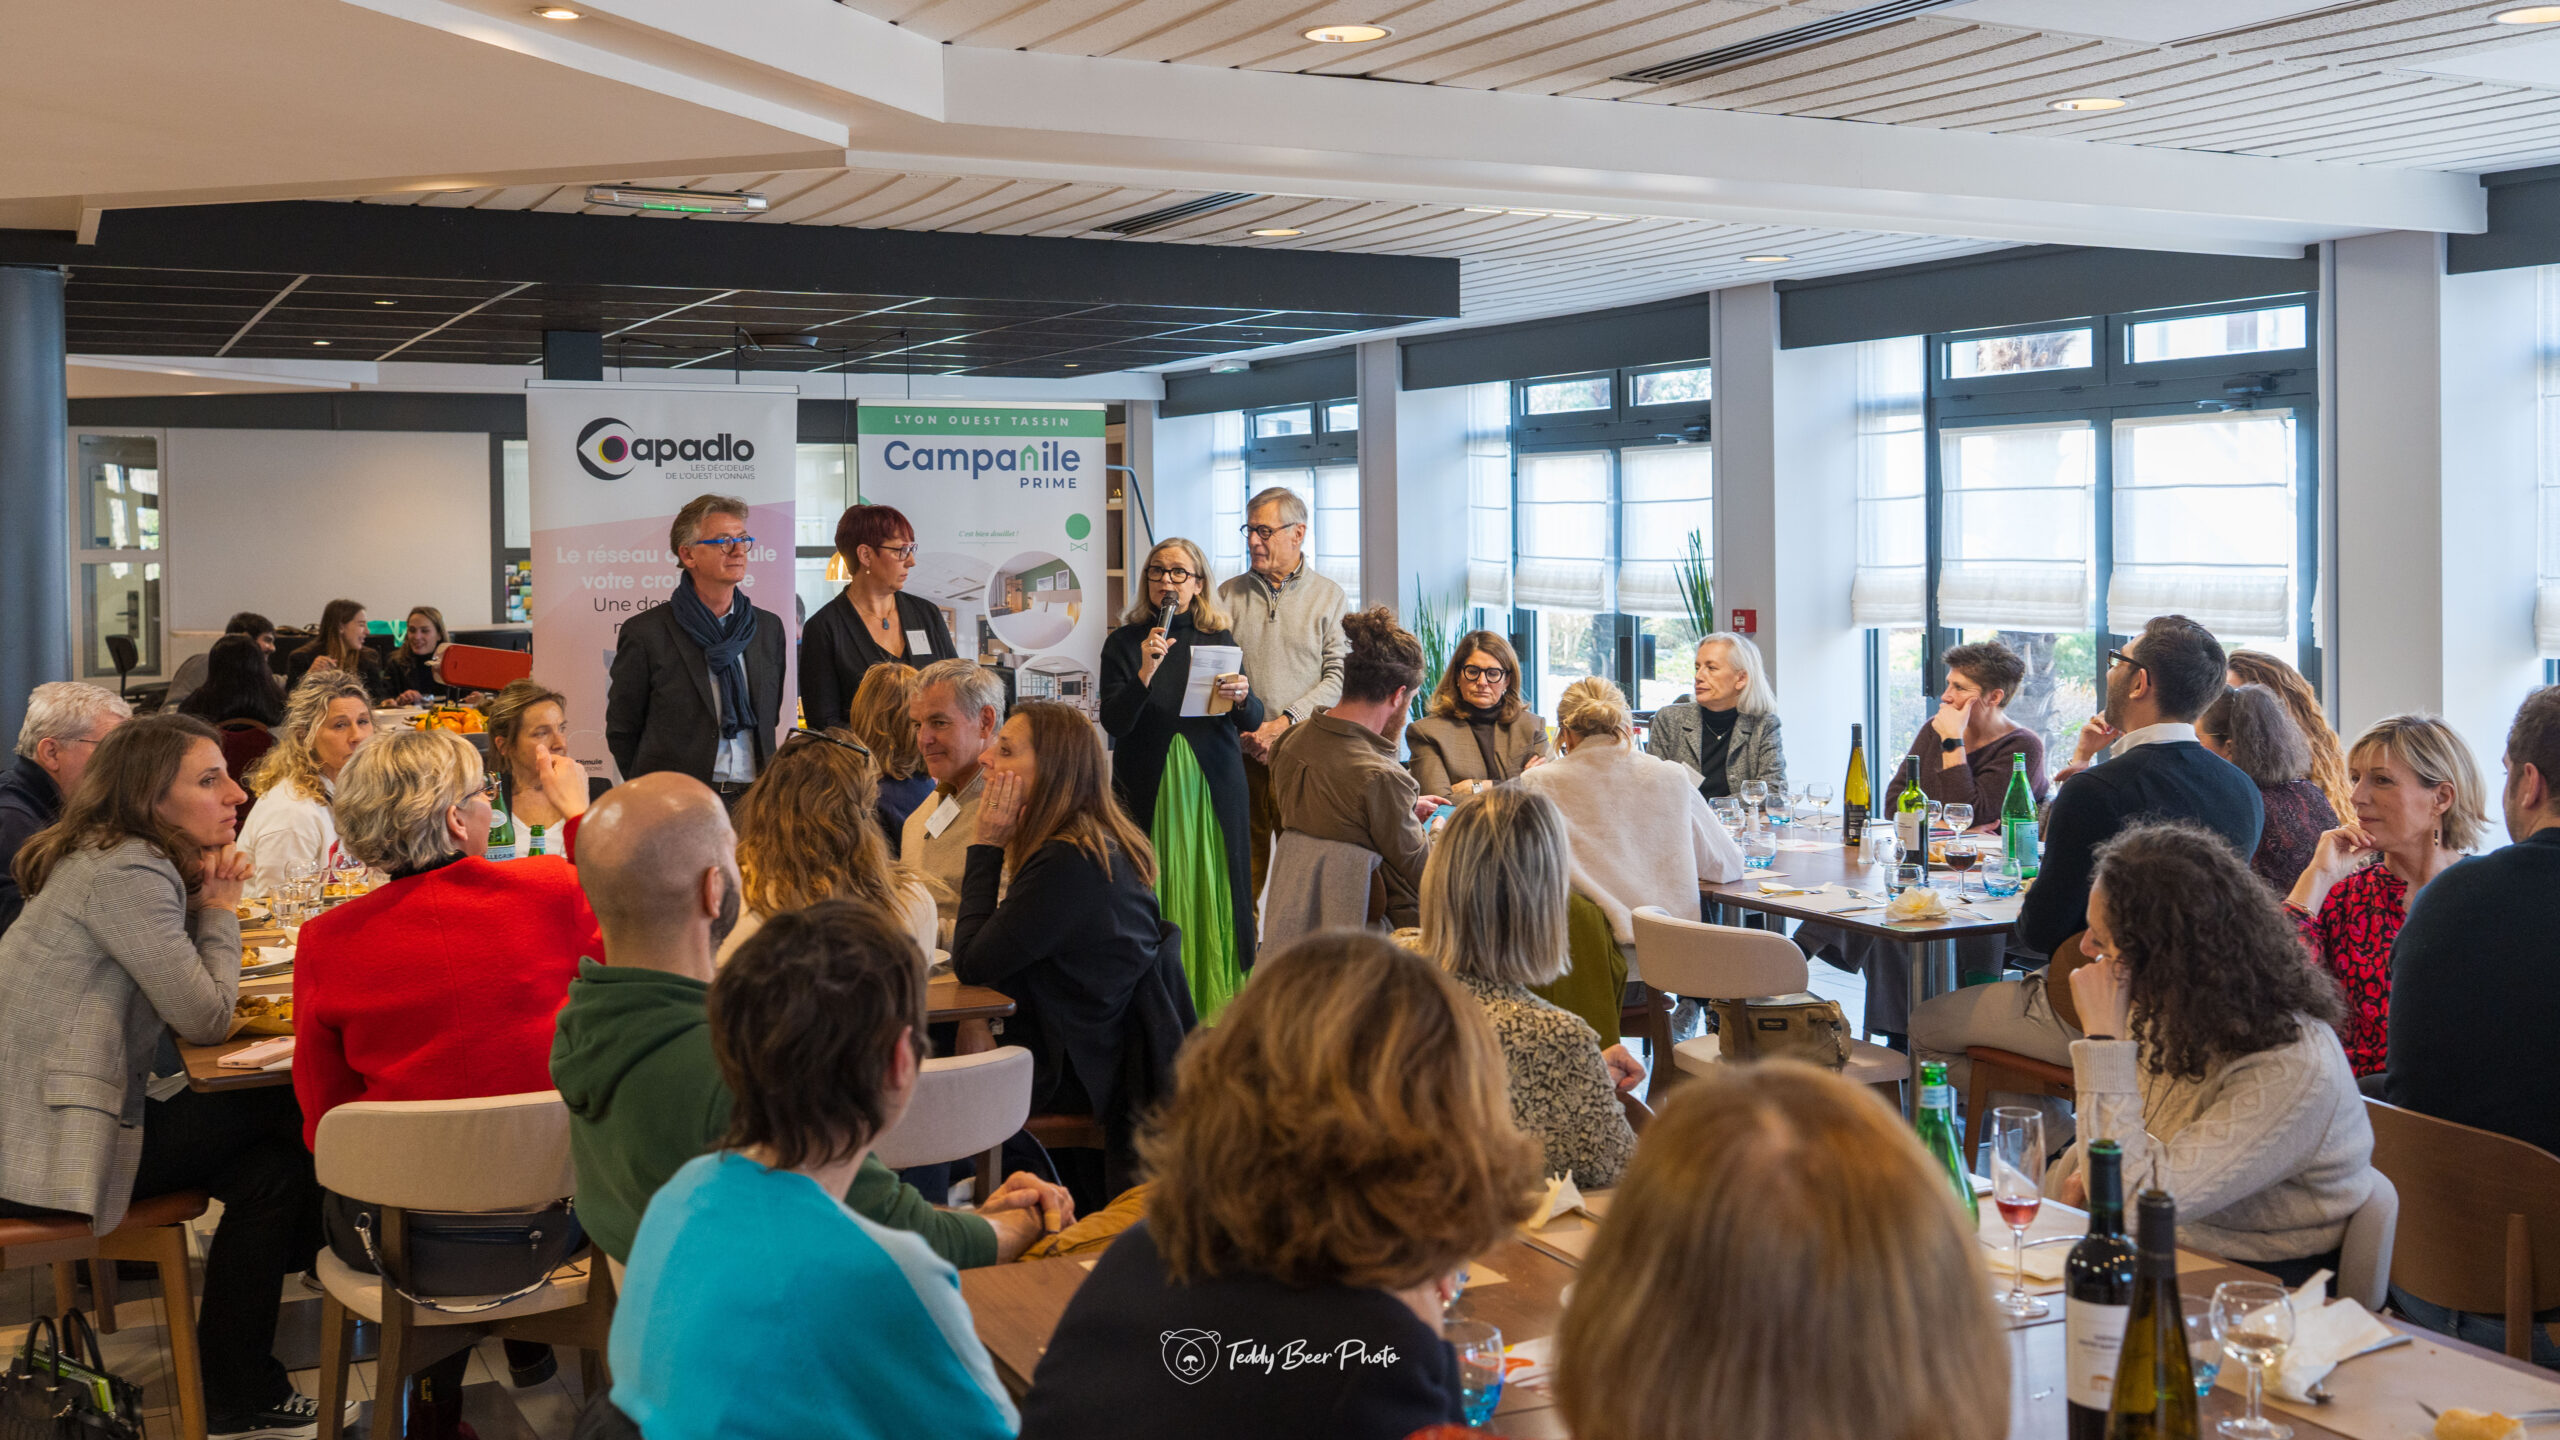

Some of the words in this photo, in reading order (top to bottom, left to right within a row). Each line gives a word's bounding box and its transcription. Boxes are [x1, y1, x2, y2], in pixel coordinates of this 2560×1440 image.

[895, 415, 937, 425] LYON
[949, 415, 1001, 426] OUEST
[1011, 416, 1069, 427] TASSIN
[884, 440, 1080, 480] Campanile
[690, 464, 706, 472] LES
[665, 472, 677, 480] DE
[679, 472, 712, 480] L'OUEST
[714, 472, 756, 480] LYONNAIS
[1020, 477, 1077, 489] PRIME
[556, 546, 580, 564] Le
[586, 544, 659, 564] réseau
[582, 571, 635, 590] votre
[594, 597, 632, 612] Une
